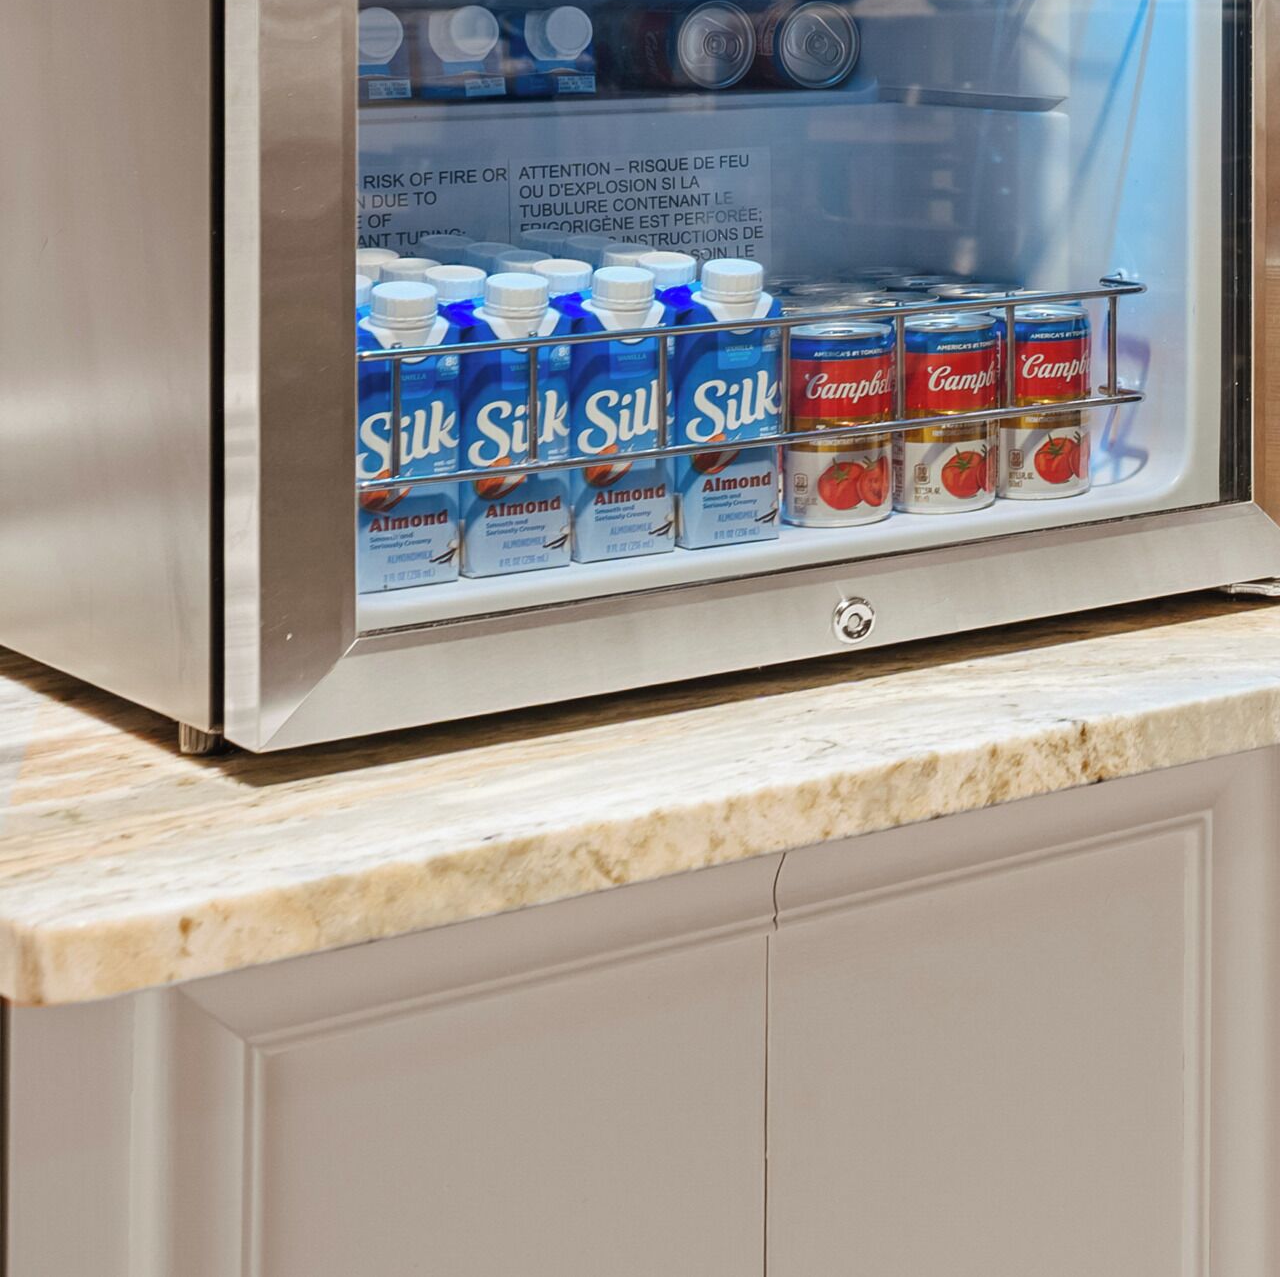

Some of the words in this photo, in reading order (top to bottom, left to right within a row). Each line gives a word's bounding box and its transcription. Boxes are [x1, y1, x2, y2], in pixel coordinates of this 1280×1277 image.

[519, 162, 610, 180] ATTENTION
[629, 158, 688, 173] RISQUE
[694, 156, 714, 170] DE
[719, 154, 749, 168] FEU
[364, 174, 404, 189] RISK
[410, 172, 432, 187] OF
[439, 170, 477, 185] FIRE
[483, 167, 507, 182] OR
[520, 185, 543, 199] OU
[549, 178, 657, 197] D'EXPLOSION
[661, 177, 675, 190] SI
[681, 175, 700, 188] LA
[372, 193, 409, 208] DUE
[413, 191, 436, 206] TO
[520, 200, 608, 218] TUBULURE
[613, 193, 710, 212] CONTENANT
[715, 192, 733, 205] LE
[368, 213, 392, 229] OF
[640, 215, 667, 229] EST
[743, 226, 763, 239] DE
[736, 245, 754, 259] LE
[725, 344, 754, 353] VANILLA
[937, 343, 972, 351] AMERICA'S
[686, 370, 782, 443] Silk
[357, 400, 459, 480] Silk
[702, 472, 772, 492] Almond
[594, 484, 666, 506] Almond
[703, 493, 730, 502] Smooth
[703, 501, 732, 509] Seriously
[733, 498, 757, 507] Creamy
[485, 496, 561, 518] Almond
[369, 509, 448, 533] Almond
